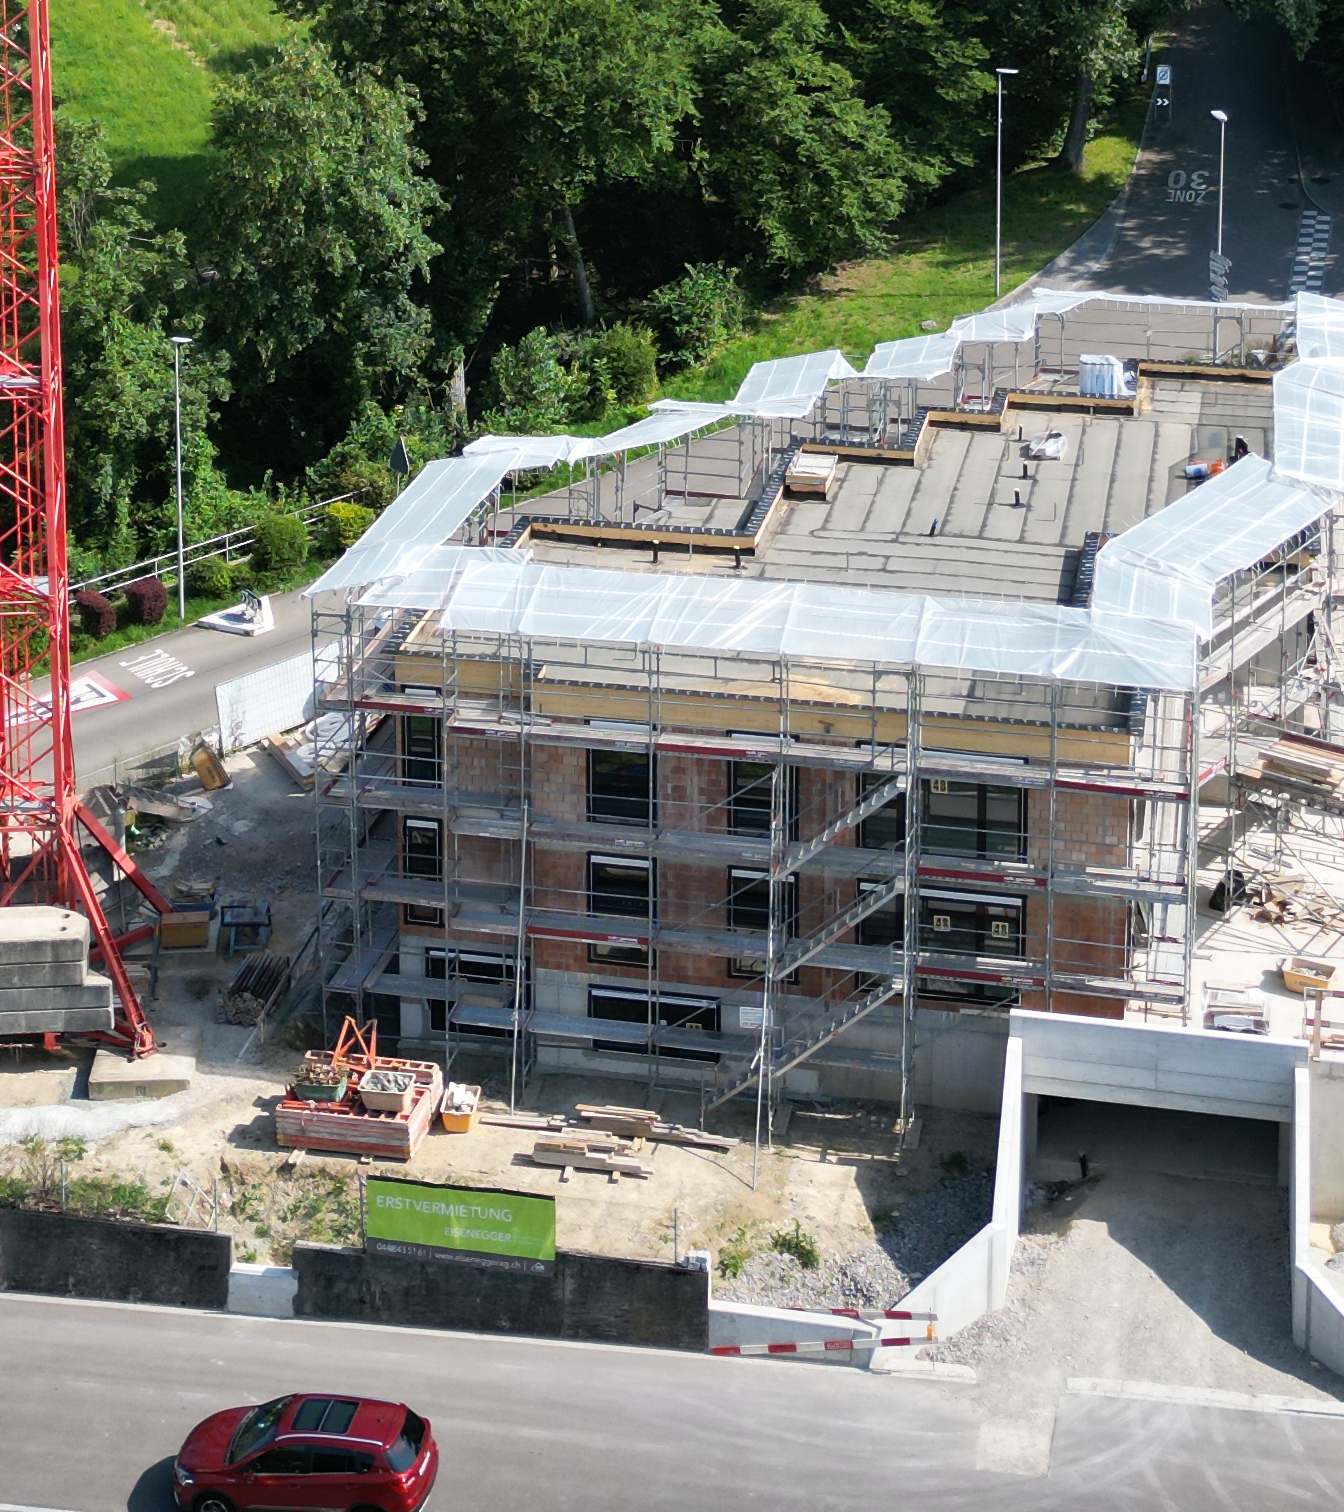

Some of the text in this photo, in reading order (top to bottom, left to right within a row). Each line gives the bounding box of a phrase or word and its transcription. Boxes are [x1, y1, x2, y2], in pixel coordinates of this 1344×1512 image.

[1167, 170, 1210, 190] 30
[1165, 189, 1206, 203] ZONE
[119, 648, 196, 689] SCHULE
[376, 1195, 513, 1222] ERSTVERMIETUNG
[444, 1226, 512, 1242] EISENEGGER
